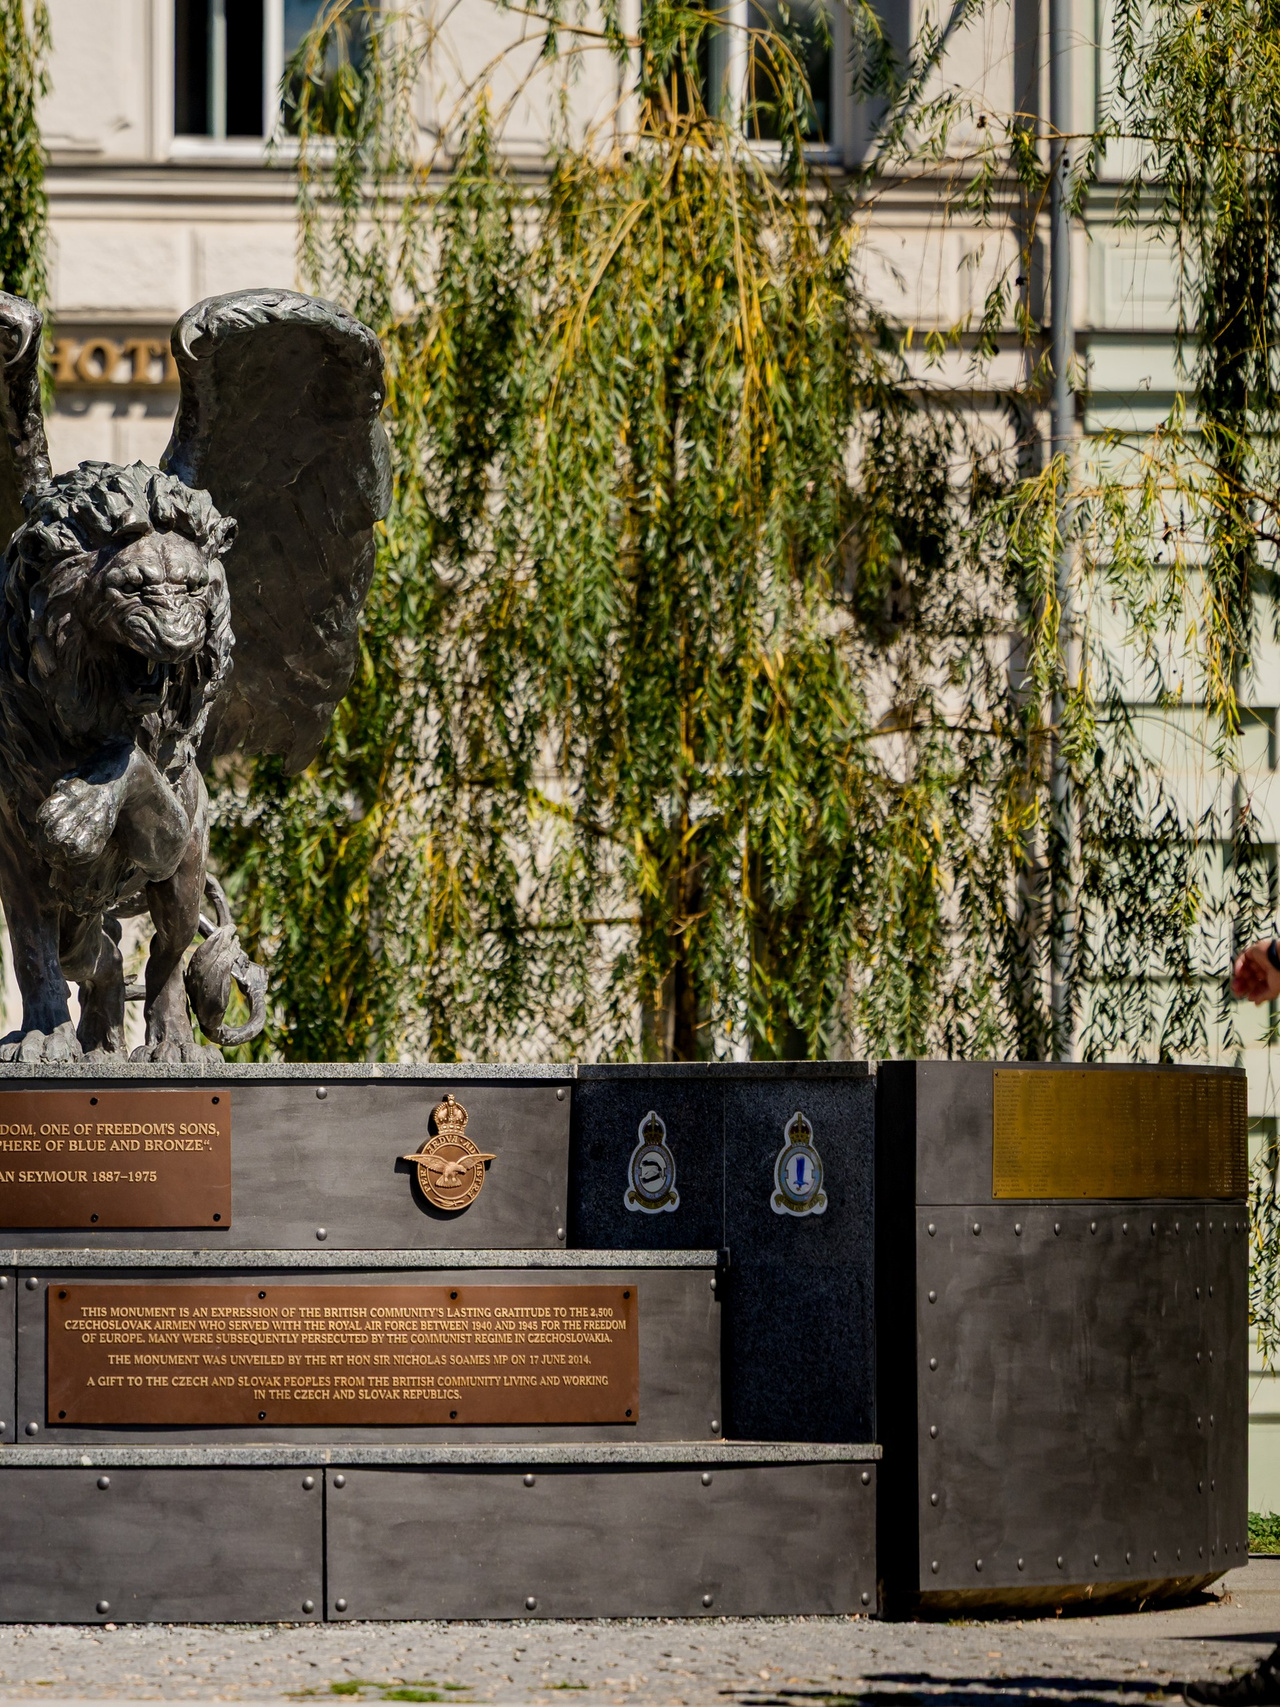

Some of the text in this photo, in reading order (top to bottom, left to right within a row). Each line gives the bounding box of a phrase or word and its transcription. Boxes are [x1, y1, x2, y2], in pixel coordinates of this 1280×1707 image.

[40, 1124, 70, 1135] ONE
[74, 1124, 92, 1134] OF
[179, 1123, 220, 1136] SONS,
[45, 1140, 65, 1151] OF
[69, 1140, 105, 1151] BLUE
[109, 1140, 140, 1150] AND
[420, 1169, 431, 1193] PER
[463, 1141, 476, 1154] AD
[18, 1171, 87, 1182] SEYMOUR
[81, 1307, 107, 1316] THIS
[110, 1307, 176, 1317] MONUMENT
[180, 1308, 189, 1317] IS
[193, 1308, 208, 1317] AN
[211, 1307, 278, 1317] EXPRESSION
[281, 1308, 295, 1317] OF
[299, 1308, 320, 1317] THE
[324, 1308, 366, 1317] BRITISH
[447, 1308, 491, 1317] LASTING
[494, 1308, 550, 1317] GRATITUDE
[554, 1307, 567, 1317] TO
[570, 1307, 588, 1317] THE
[590, 1308, 613, 1318] 2,500
[65, 1320, 626, 1330] CZECHOSLOVAK AIRMEN WHO SERVED WITH THE ROYAL AIR FORCE BETWEEN 1940 AND 1945 FOR THE FREEDOM
[82, 1333, 612, 1345] OF EUROPE. MANY WERE SUBSEQUENTLY PERSECUTED BY THE COMMUNIST REGIME IN CZECHOSLOVAKIA.
[108, 1355, 591, 1365] THE MONUMENT WAS UNVEILED BY THE RT HON SIR NICHOLAS SOAMES MP ON 17 JUNE 2014.
[98, 1376, 608, 1386] GIFT TO THE CZECH AND SLOVAK PEOPLES FROM THE BRITISH COMMUNITY LIVING AND WORKING
[254, 1389, 462, 1399] IN THE CZECH AND SLOVAK REPUBLICS.
